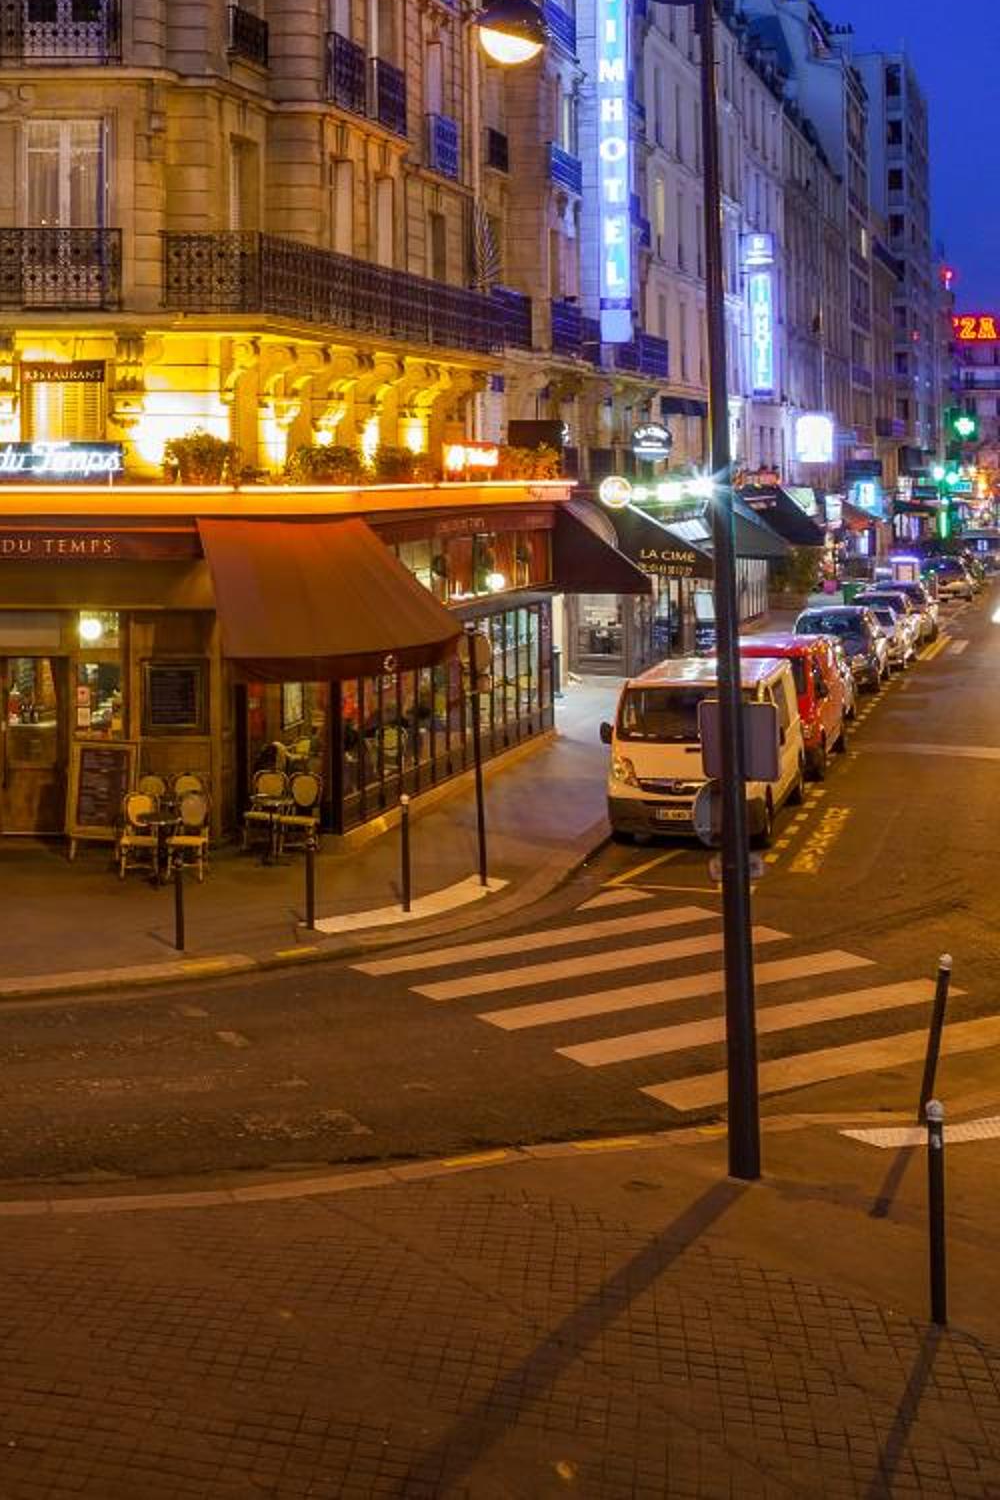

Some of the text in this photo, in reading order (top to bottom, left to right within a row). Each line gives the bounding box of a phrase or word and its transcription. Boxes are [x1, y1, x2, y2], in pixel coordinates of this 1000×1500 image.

[24, 370, 102, 381] RESTAURANT
[30, 441, 121, 476] Temps
[3, 540, 31, 553] DU
[45, 539, 113, 553] TEMPS
[641, 549, 658, 559] LA
